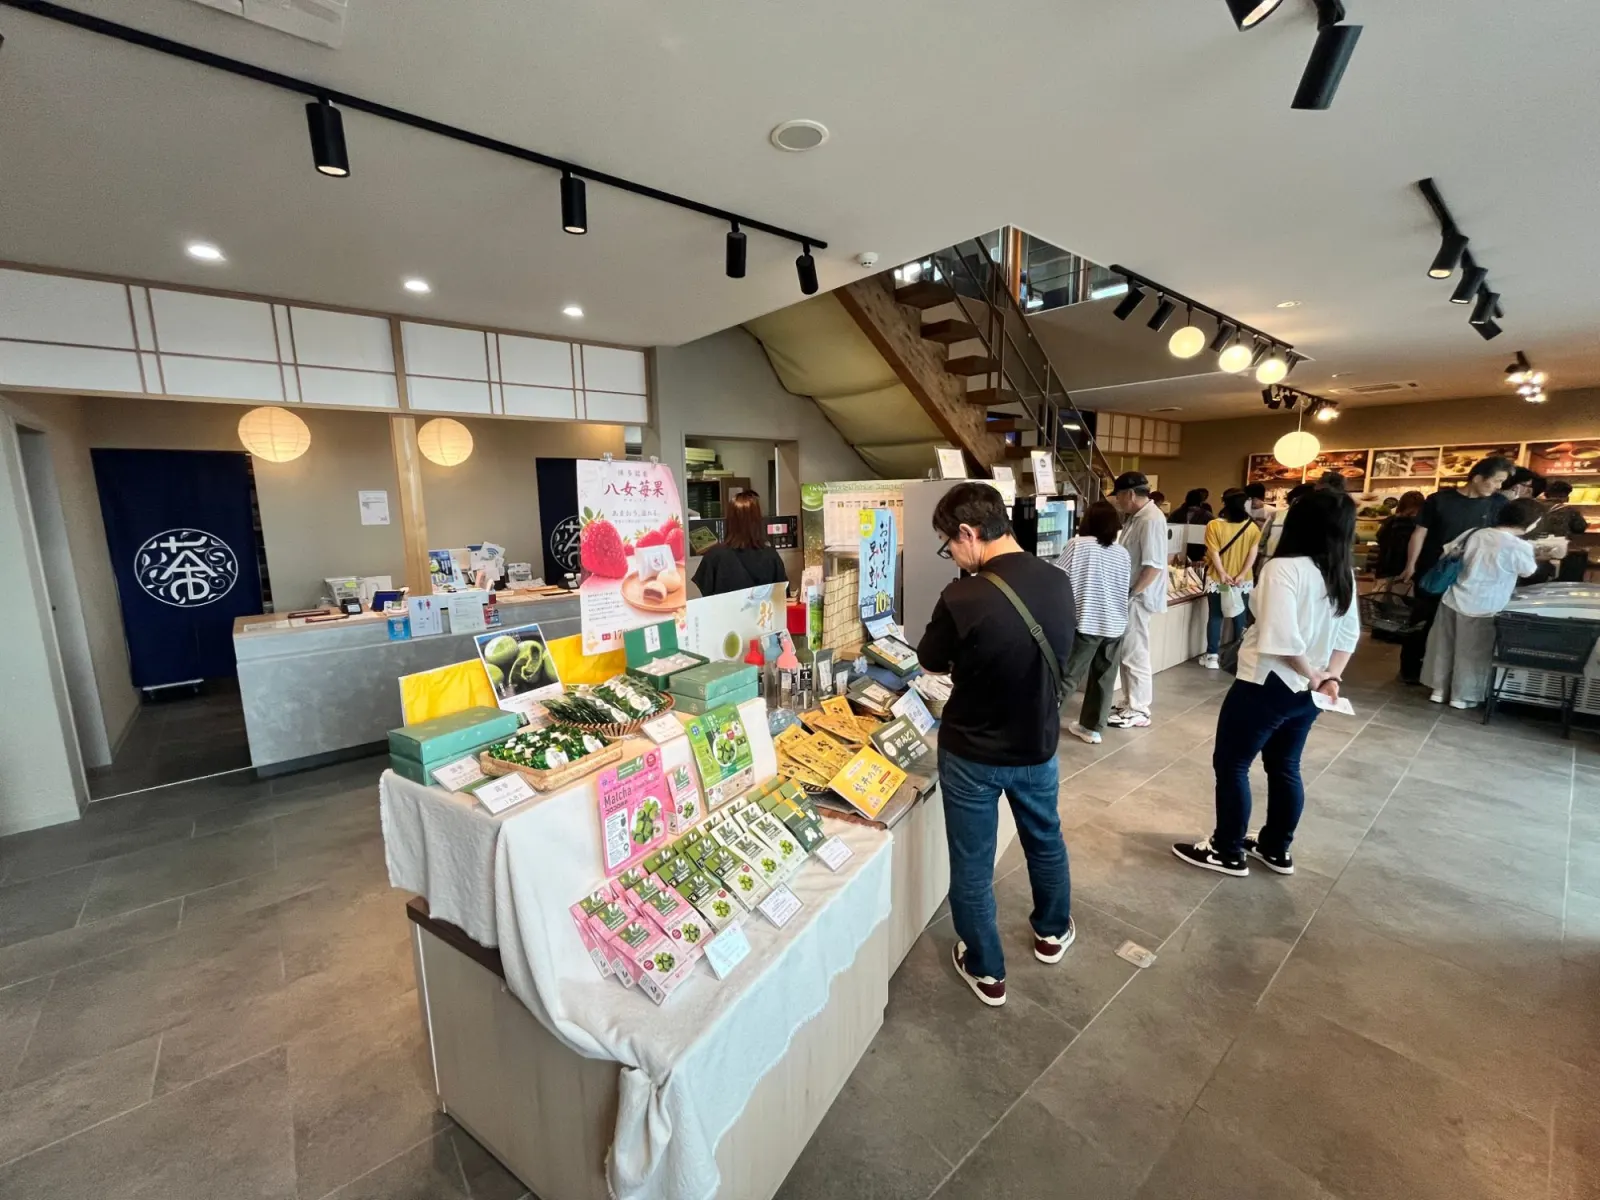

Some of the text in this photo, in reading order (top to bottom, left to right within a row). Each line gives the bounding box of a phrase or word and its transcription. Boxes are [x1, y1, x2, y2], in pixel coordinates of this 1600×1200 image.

[603, 479, 665, 498] 八女苺果
[603, 787, 633, 809] Matcha
